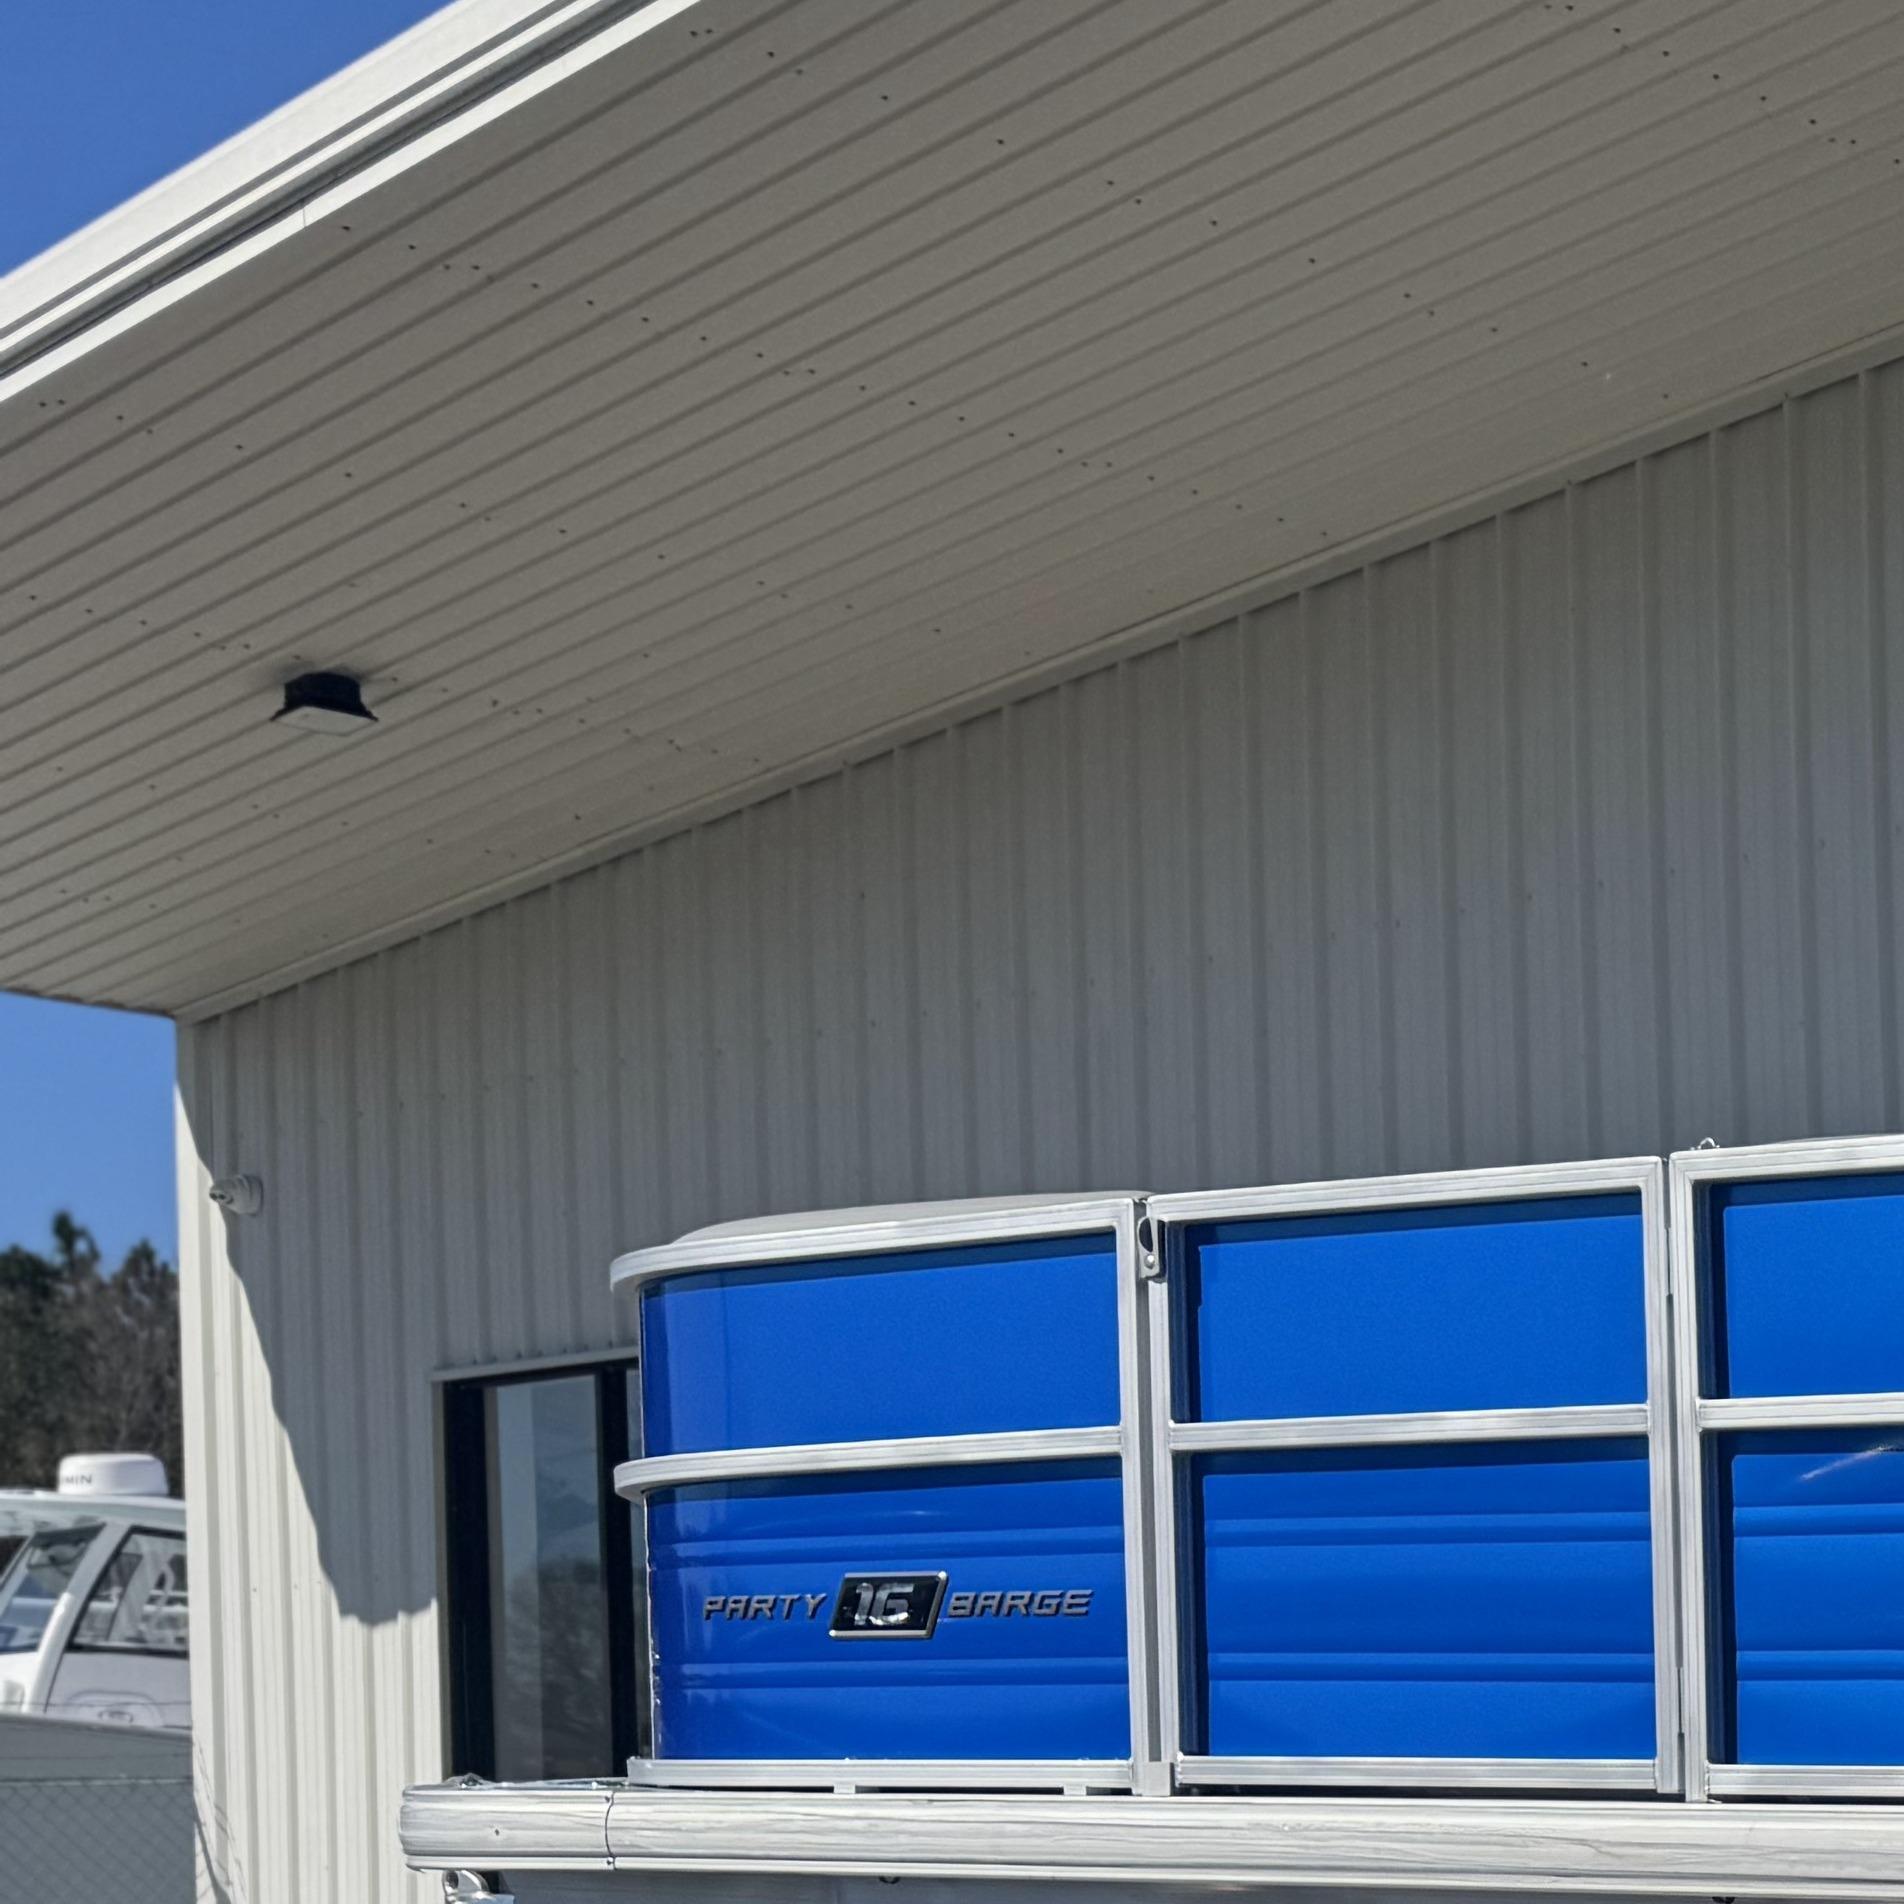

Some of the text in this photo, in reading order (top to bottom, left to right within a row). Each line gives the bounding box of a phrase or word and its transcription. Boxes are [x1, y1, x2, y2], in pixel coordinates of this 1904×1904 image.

[702, 1581, 1096, 1627] PARTY 16 BARGE
